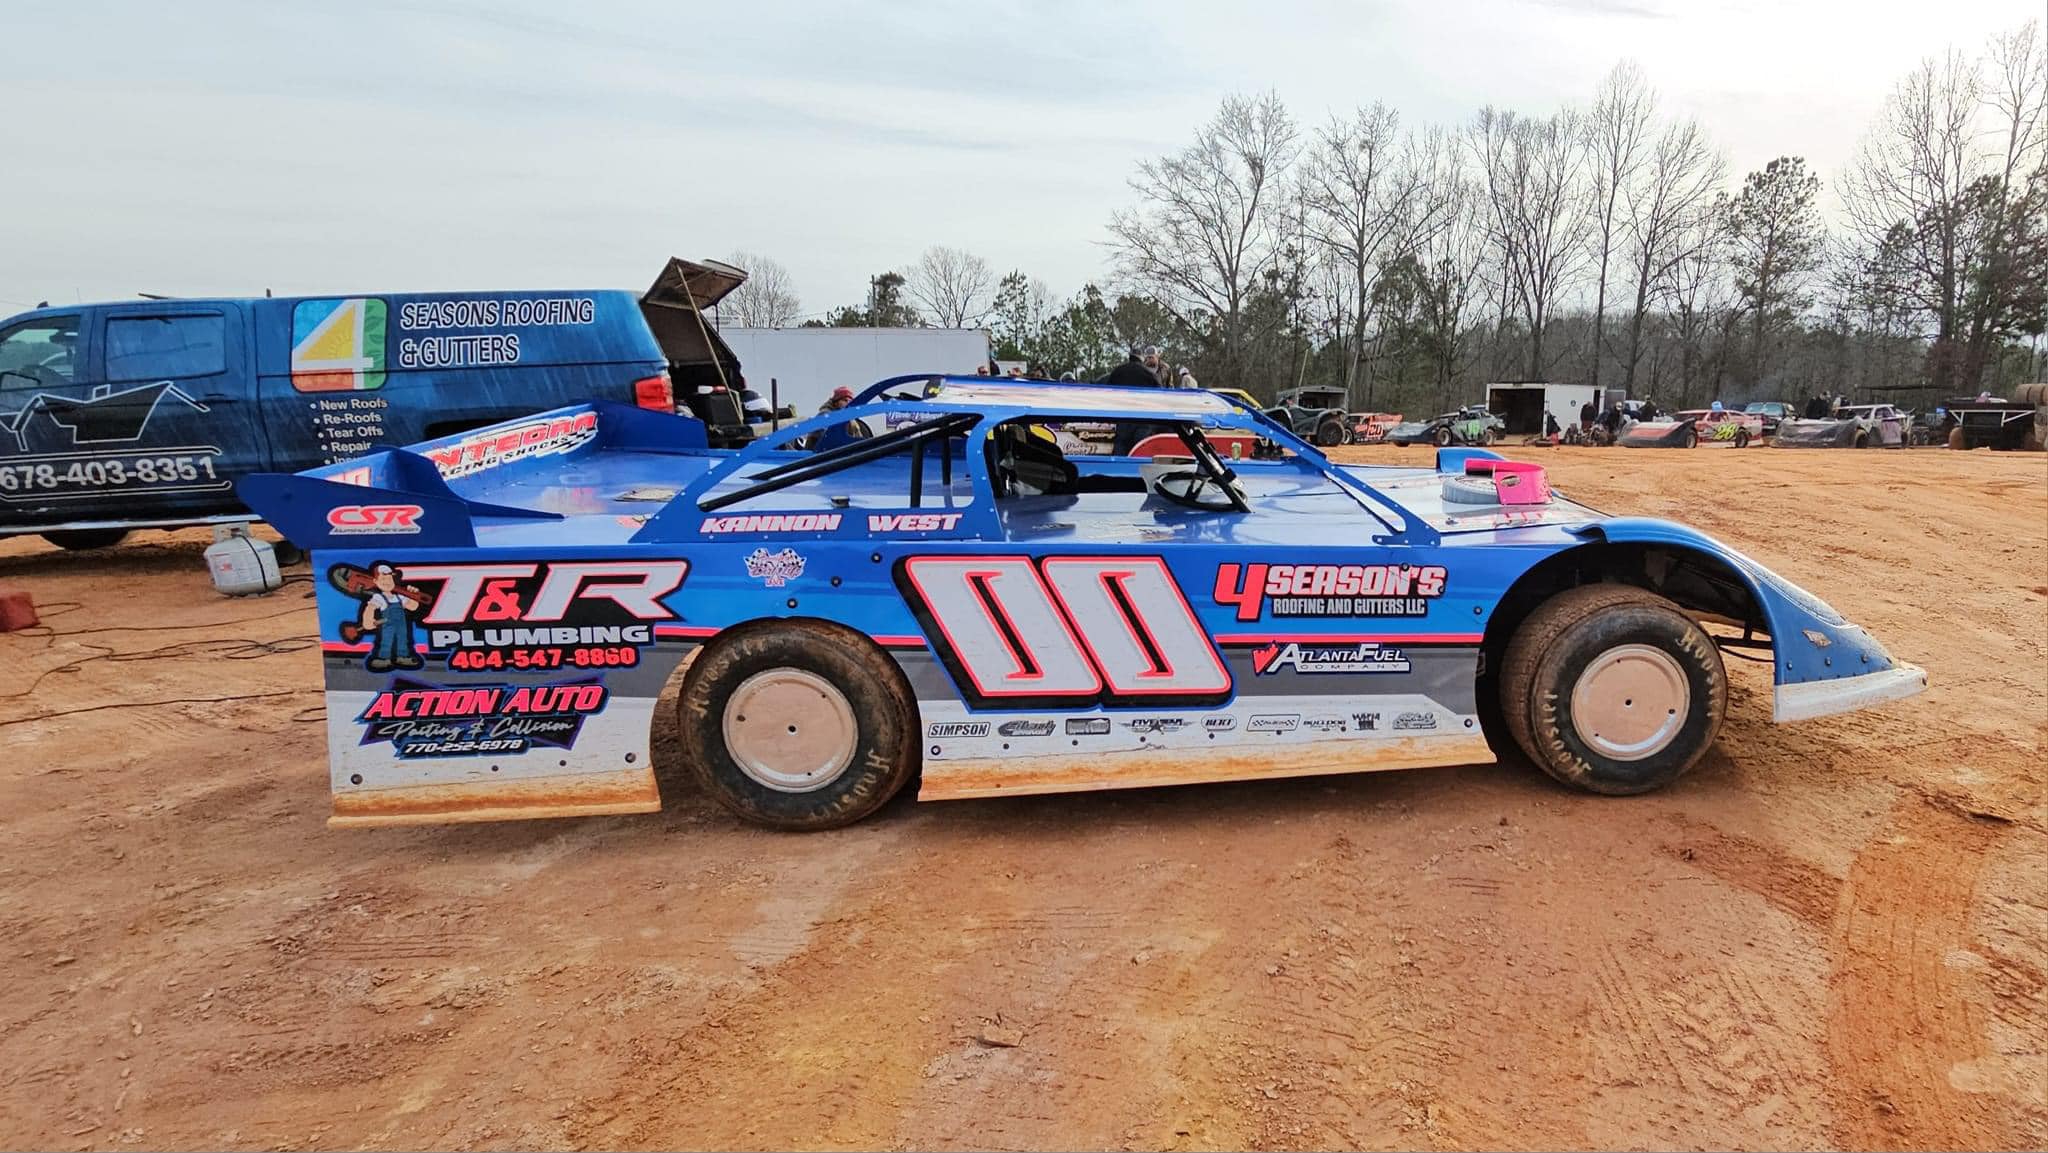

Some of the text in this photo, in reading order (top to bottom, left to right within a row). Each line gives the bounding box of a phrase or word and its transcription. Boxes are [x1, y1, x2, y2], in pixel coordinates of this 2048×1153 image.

[400, 298, 594, 329] SEASONS ROOFING
[320, 398, 388, 411] New Roofs
[323, 412, 383, 425] Re-Roofs
[326, 426, 384, 439] Tear Offs
[428, 414, 598, 466] NTEGRA
[331, 441, 373, 453] Repair
[503, 437, 570, 460] SHOCKS
[0, 456, 217, 490] 678-403-8351
[329, 506, 422, 526] CSR
[700, 514, 963, 533] KANNON WEST
[395, 561, 689, 625] T&R
[1215, 563, 1446, 620] 4 SEASON'S
[1273, 598, 1426, 615] ROOFING AND GUTTERS LLC
[432, 625, 651, 648] PLUMBING
[905, 556, 1233, 697] 00
[451, 647, 636, 669] 404-547-8860
[1300, 663, 1401, 671] COMPANY
[364, 685, 604, 719] ACTION AUTO
[490, 716, 574, 738] Collision
[930, 723, 988, 736] SIMPSON
[405, 740, 524, 754] 770-252-6978
